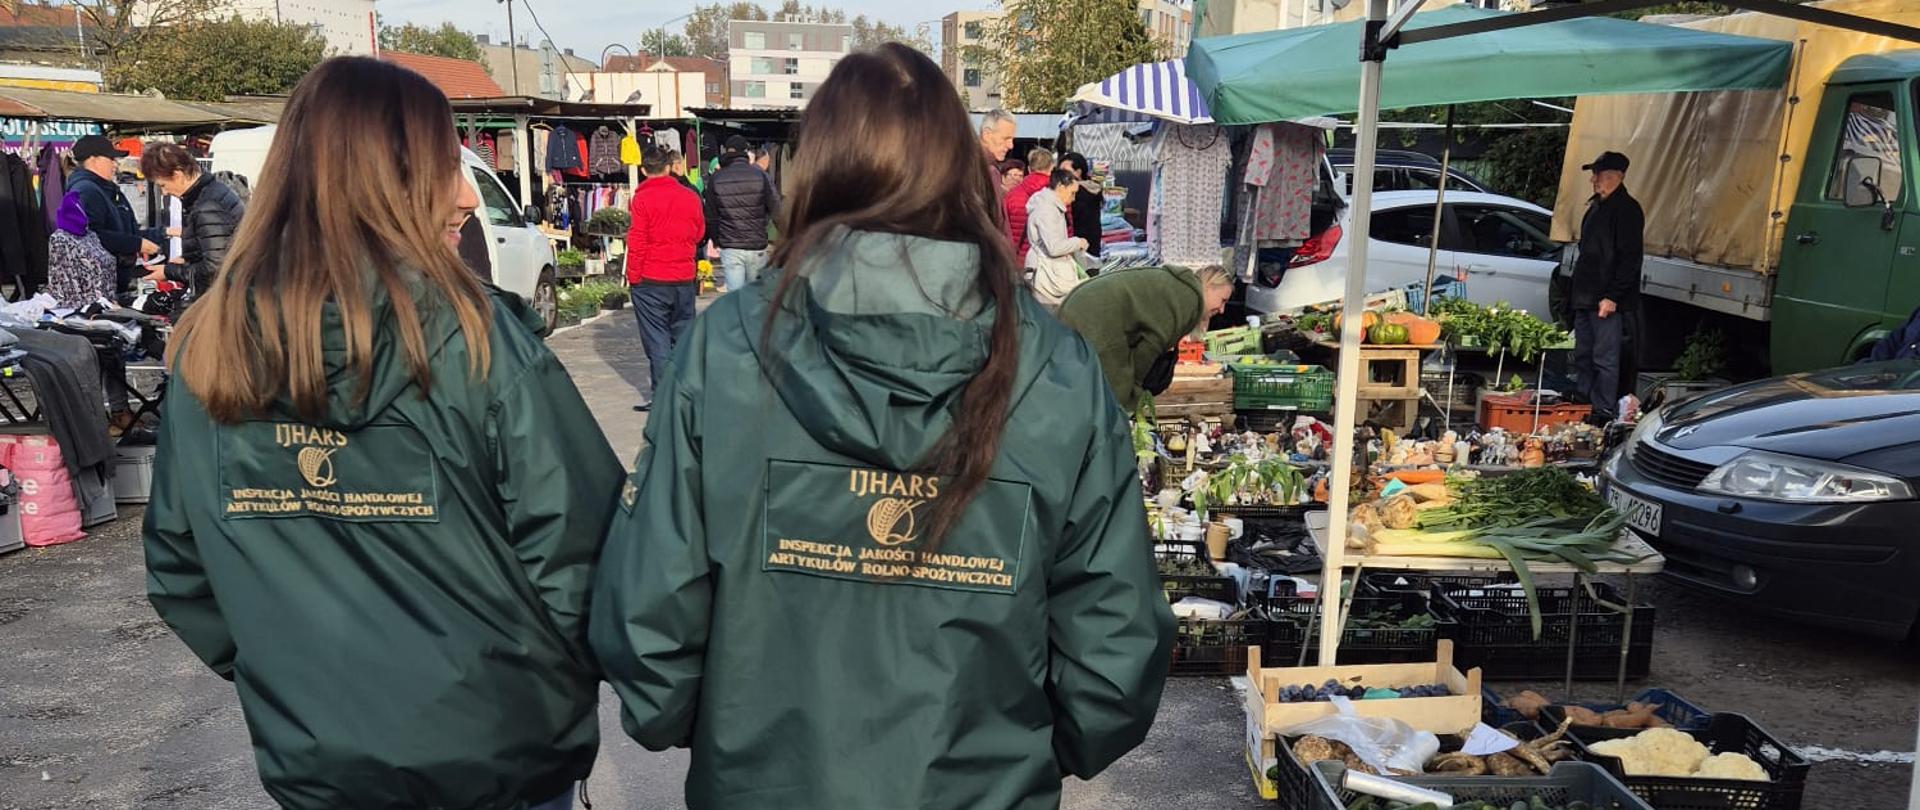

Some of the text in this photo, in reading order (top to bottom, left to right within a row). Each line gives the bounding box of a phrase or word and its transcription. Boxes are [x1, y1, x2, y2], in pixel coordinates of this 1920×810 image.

[276, 424, 348, 446] IJHARS
[850, 470, 939, 498] IJHARS
[232, 488, 294, 499] INSPEKCJA
[344, 493, 422, 504] HANDLOWEJ
[779, 539, 853, 557] INSPEKCJA
[858, 548, 915, 562] JAKOŚCI
